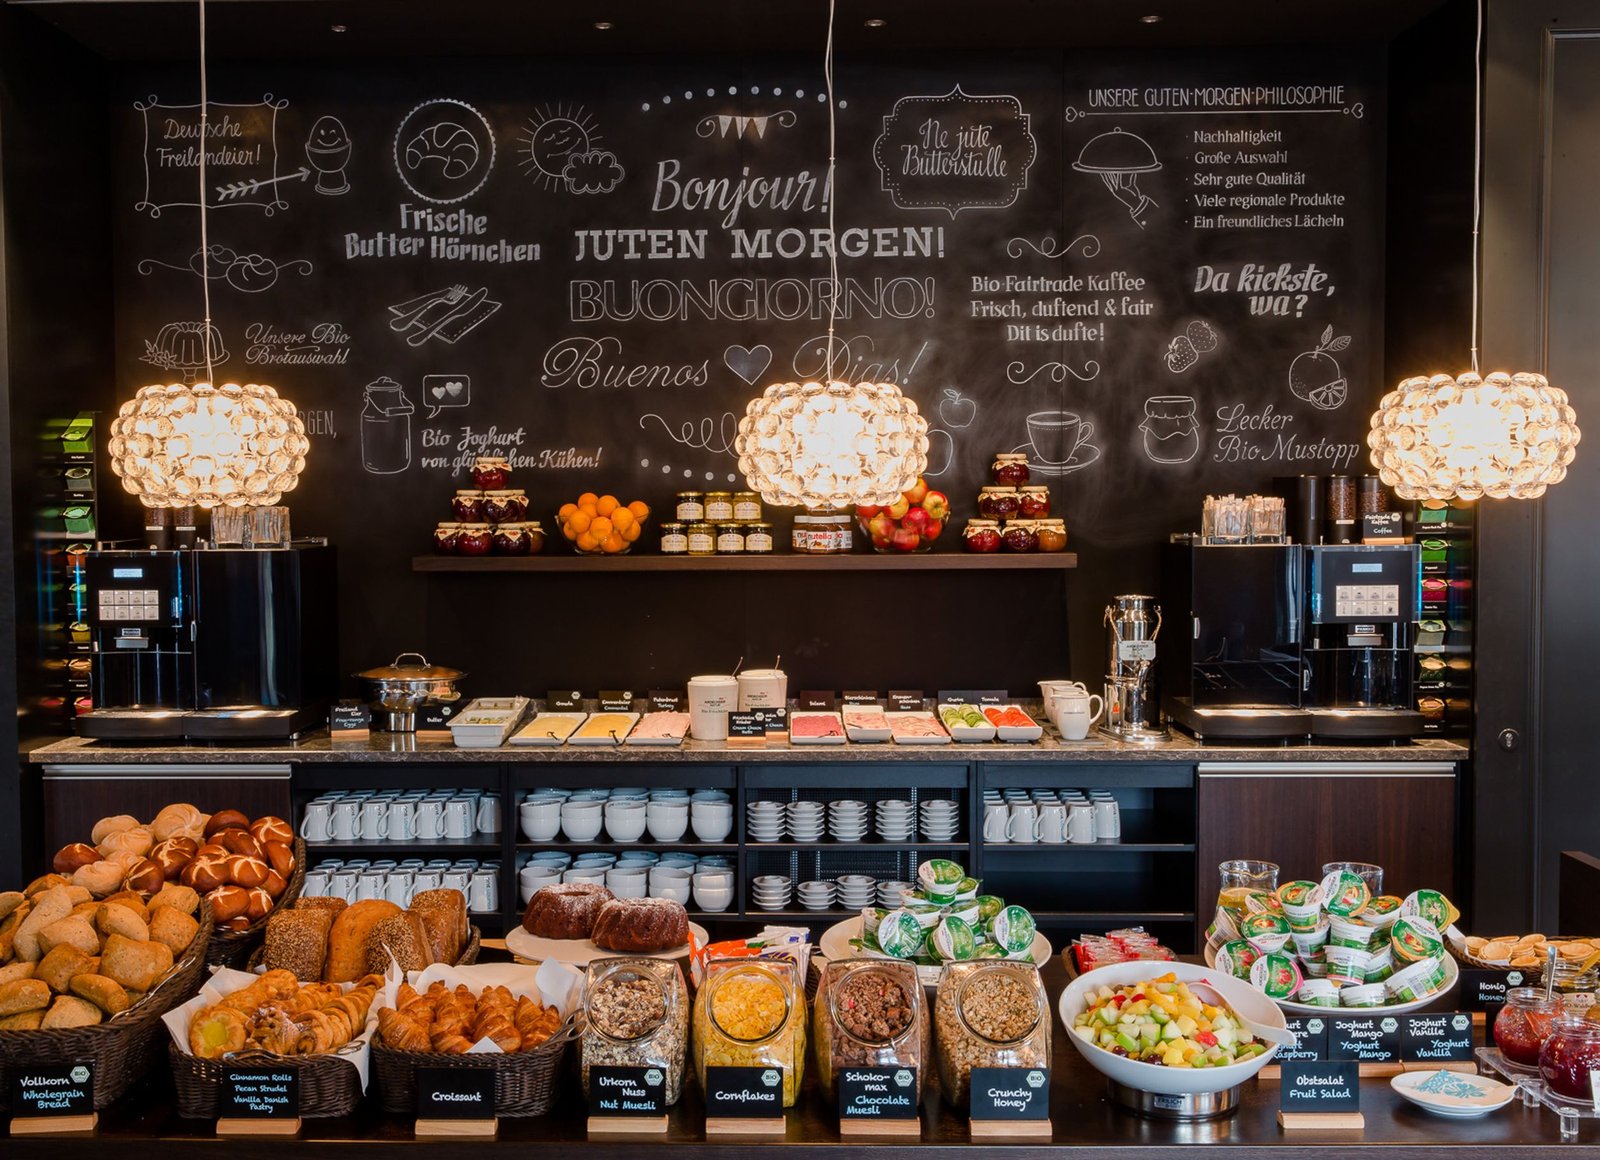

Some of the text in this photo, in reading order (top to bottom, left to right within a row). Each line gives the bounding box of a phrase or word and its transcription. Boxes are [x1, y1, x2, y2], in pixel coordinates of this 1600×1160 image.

[1089, 88, 1139, 107] UNSERE
[164, 118, 242, 140] Deutsche
[919, 118, 993, 158] Ne jute
[1193, 129, 1283, 145] Nachhaltigkeit
[157, 144, 261, 168] Freilandeier!
[902, 144, 1008, 178] Butterstulle
[1194, 150, 1289, 165] Große Auswahl
[1193, 171, 1306, 189] Sehr gute Qualität
[652, 159, 835, 230] Bonjour!
[1194, 192, 1346, 210] Viele regionale Produkte
[400, 203, 487, 235] Frische
[1194, 213, 1345, 229] Ein freundliches Lächeln
[345, 231, 541, 263] Butter Hörnchen
[575, 227, 946, 262] JUTEN MORGEN!
[1087, 272, 1146, 293] Kaffee
[1194, 263, 1336, 297] Da kiekste,
[570, 277, 935, 322] BUONGIORNO!
[970, 297, 1154, 319] Frisch, duftend & fair
[1249, 294, 1308, 319] wa?
[245, 322, 351, 346] Unsere Bio
[1007, 323, 1105, 343] Dit is dufte!
[245, 344, 349, 366] Brotauswahl
[541, 336, 710, 388] Buenos
[1216, 404, 1294, 432] Lecker
[421, 426, 527, 453] Bio Joghurt
[421, 456, 449, 468] von
[539, 447, 602, 469] Kühen!
[1214, 434, 1360, 469] Bio Mustopp
[807, 532, 833, 540] nutella
[1479, 982, 1506, 993] Honig
[1478, 993, 1506, 1002] Honey
[1335, 1020, 1374, 1033] Joghurt
[1409, 1018, 1447, 1031] Joghurt
[1350, 1030, 1384, 1041] Mango
[1408, 1027, 1445, 1037] Vanille
[1341, 1040, 1380, 1053] Yoghurt
[1430, 1039, 1470, 1051] Yoghurt
[1359, 1050, 1392, 1061] Mango
[1416, 1048, 1452, 1058] Vanilla
[75, 1069, 86, 1077] BIO
[230, 1073, 292, 1081] Cinnamon Rolls
[846, 1072, 891, 1082] Schoko-
[1296, 1073, 1344, 1086] Obstsalat
[20, 1076, 70, 1088] Vollkorn
[234, 1084, 287, 1093] Pecan Strudel
[599, 1077, 637, 1087] Urkorn
[864, 1084, 888, 1092] max
[22, 1090, 85, 1101] Wholegrain
[432, 1092, 482, 1102] Croissant
[622, 1087, 646, 1096] Nuss
[715, 1090, 775, 1103] Cornflakes
[987, 1088, 1032, 1102] Crunchy
[1289, 1088, 1352, 1099] Fruit Salad
[37, 1099, 71, 1110] Bread
[234, 1095, 289, 1103] Vanilla Danish
[600, 1099, 656, 1110] Nut Muesli
[855, 1095, 910, 1105] Chocolate
[993, 1098, 1027, 1111] Honey
[249, 1102, 273, 1113] Pastry
[846, 1104, 881, 1115] Muesli
